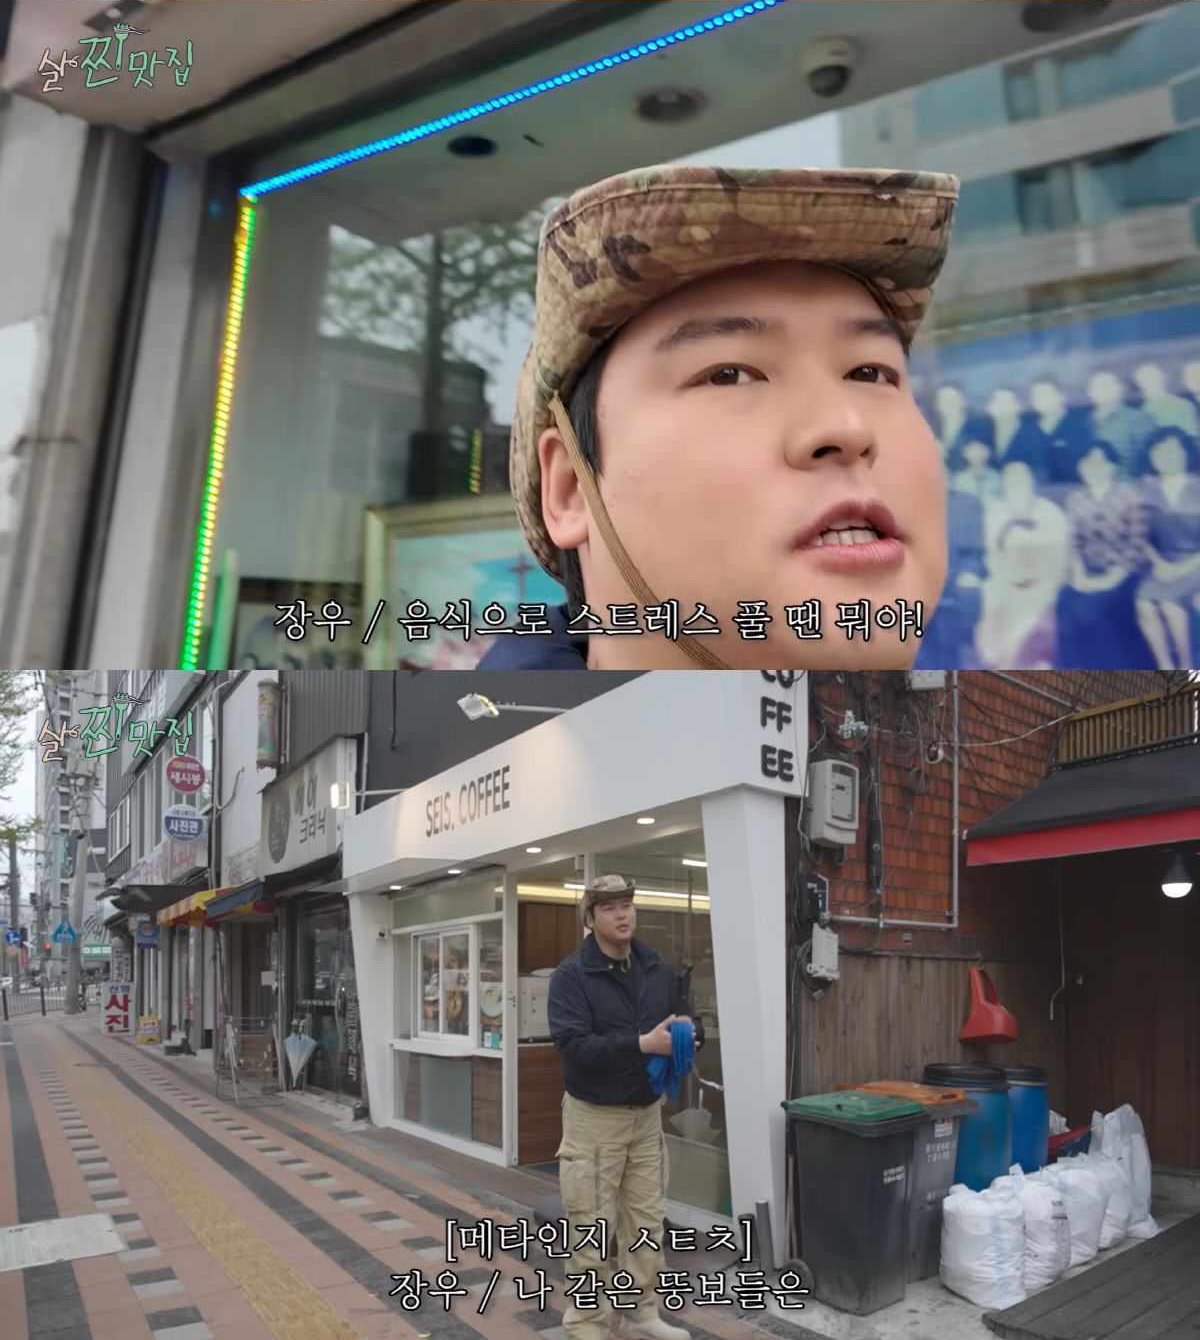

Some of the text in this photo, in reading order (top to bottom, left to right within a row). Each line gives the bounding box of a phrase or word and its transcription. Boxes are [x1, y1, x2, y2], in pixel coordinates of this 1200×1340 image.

[170, 771, 202, 786] 세시봉
[459, 764, 511, 825] COFFEE
[169, 819, 199, 834] 사진관
[108, 984, 130, 994] 신영
[104, 994, 131, 1033] 사진
